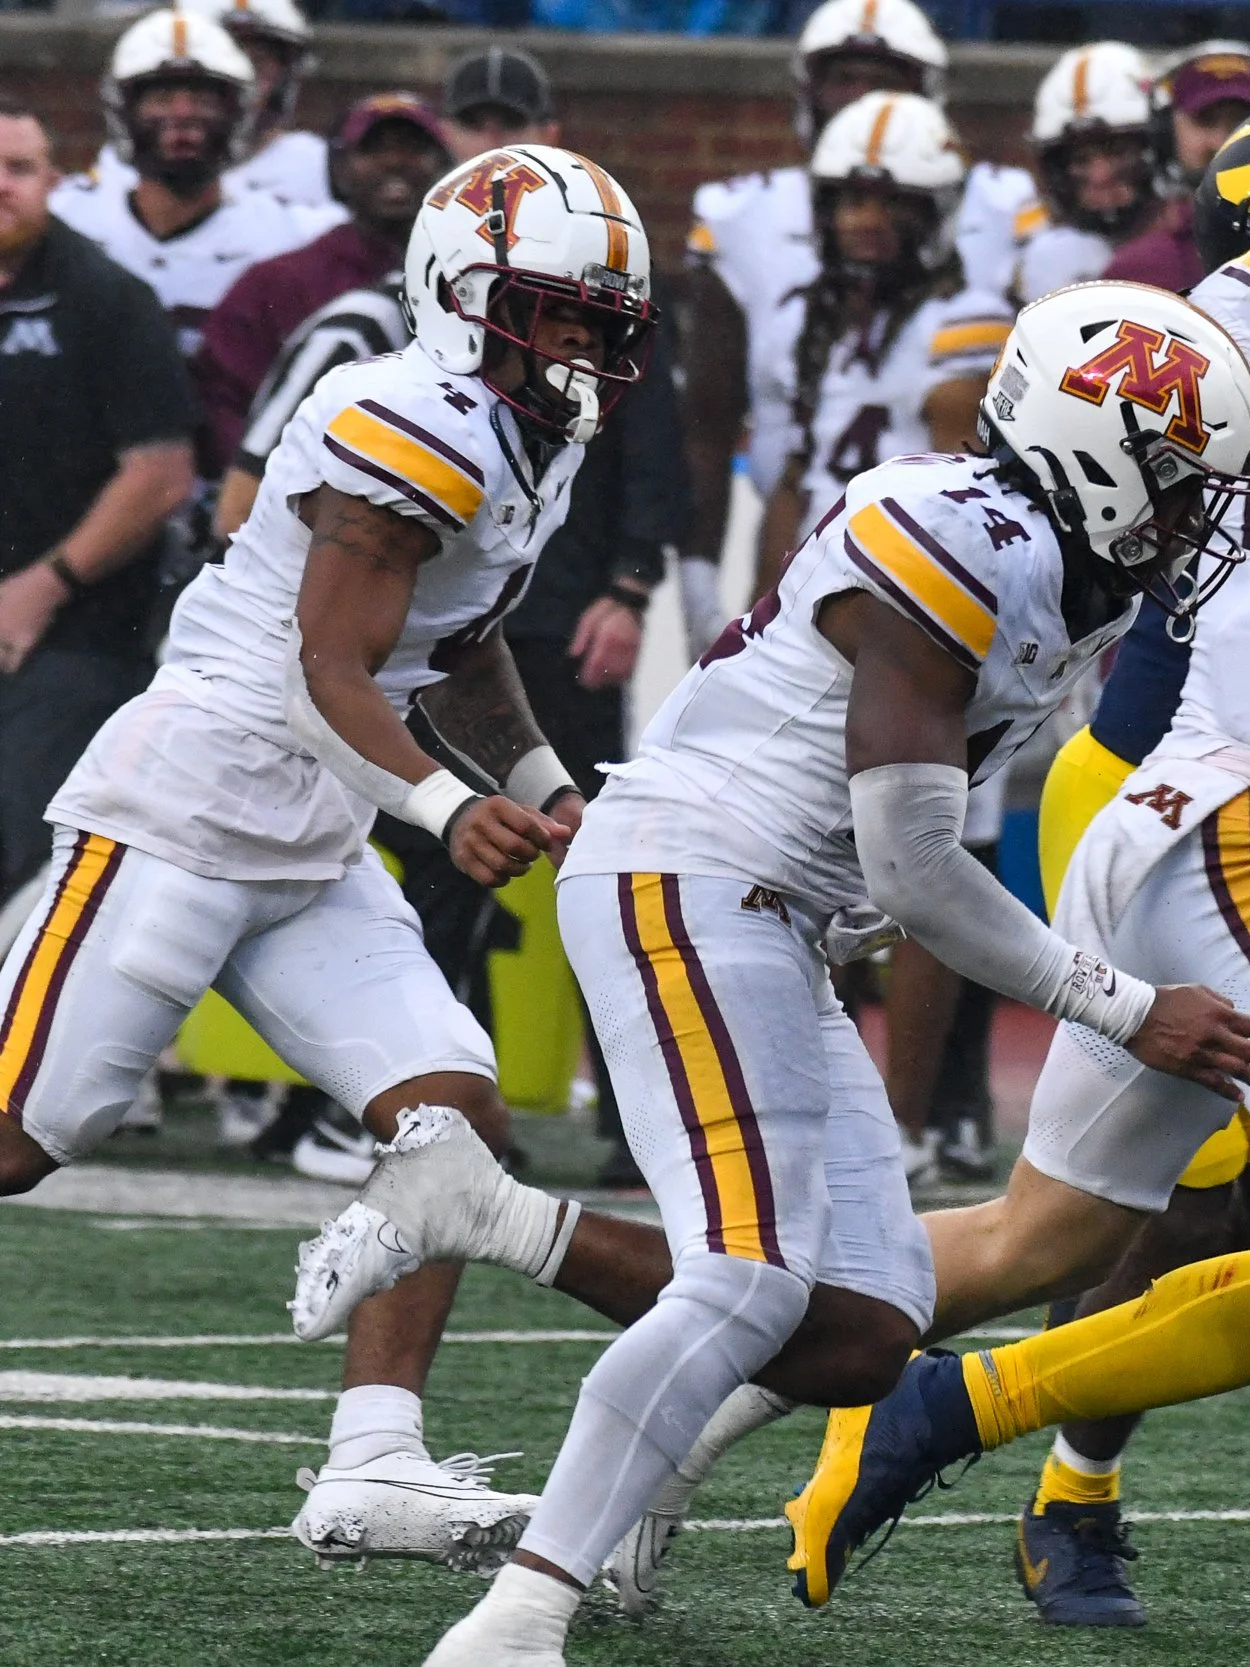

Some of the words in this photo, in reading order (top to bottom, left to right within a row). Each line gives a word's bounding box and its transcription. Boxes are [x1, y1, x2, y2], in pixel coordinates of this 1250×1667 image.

[435, 382, 478, 416] 4
[1058, 319, 1211, 456] M
[826, 404, 892, 484] 4
[938, 487, 1032, 552] 14
[1124, 783, 1194, 831] M
